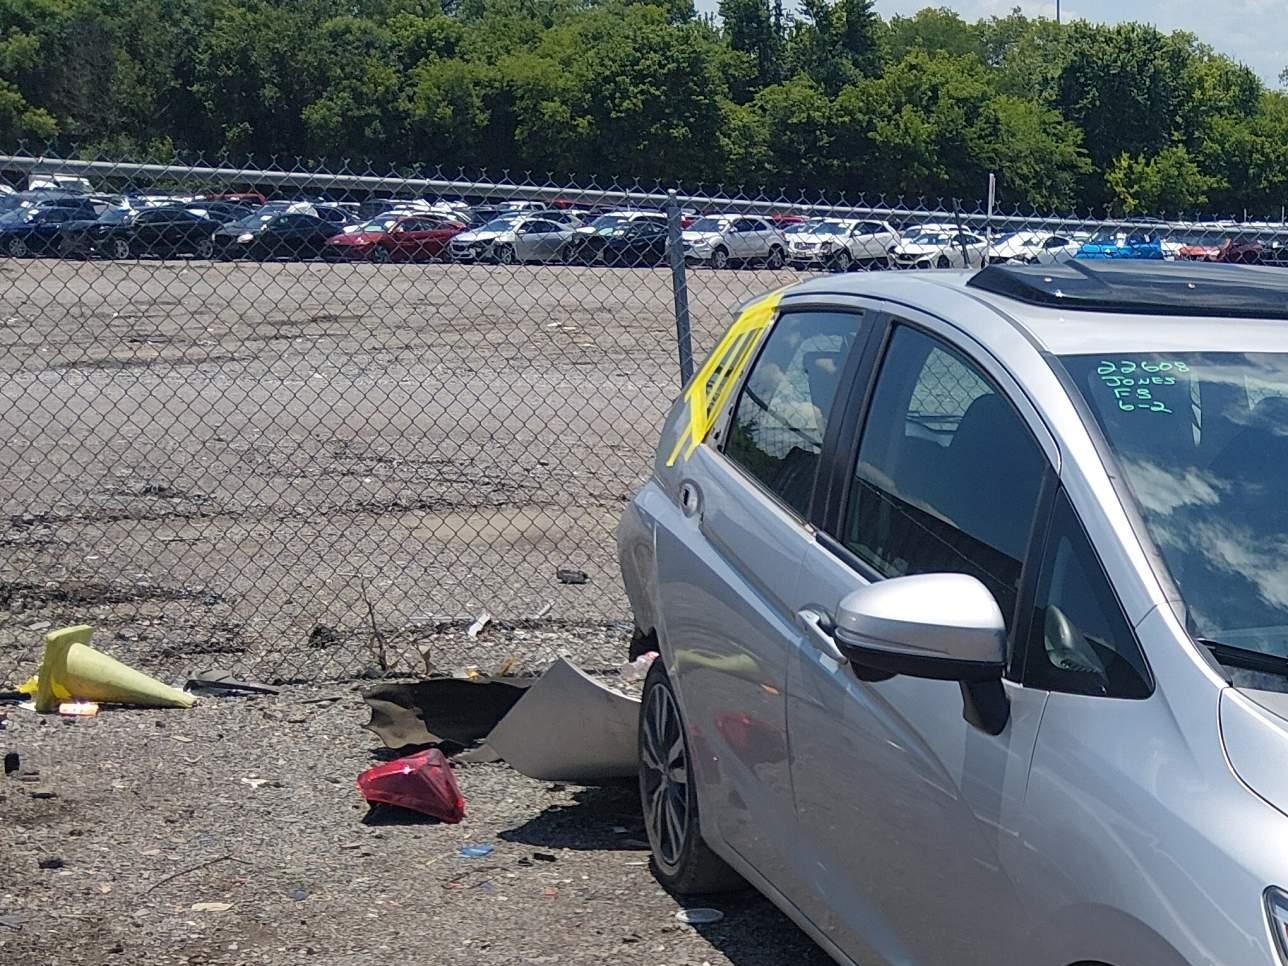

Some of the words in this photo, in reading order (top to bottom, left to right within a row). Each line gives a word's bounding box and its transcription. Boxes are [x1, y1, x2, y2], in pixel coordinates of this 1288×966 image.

[1097, 360, 1190, 375] 22608
[1101, 376, 1176, 387] JONES
[1118, 399, 1173, 414] 6-2
